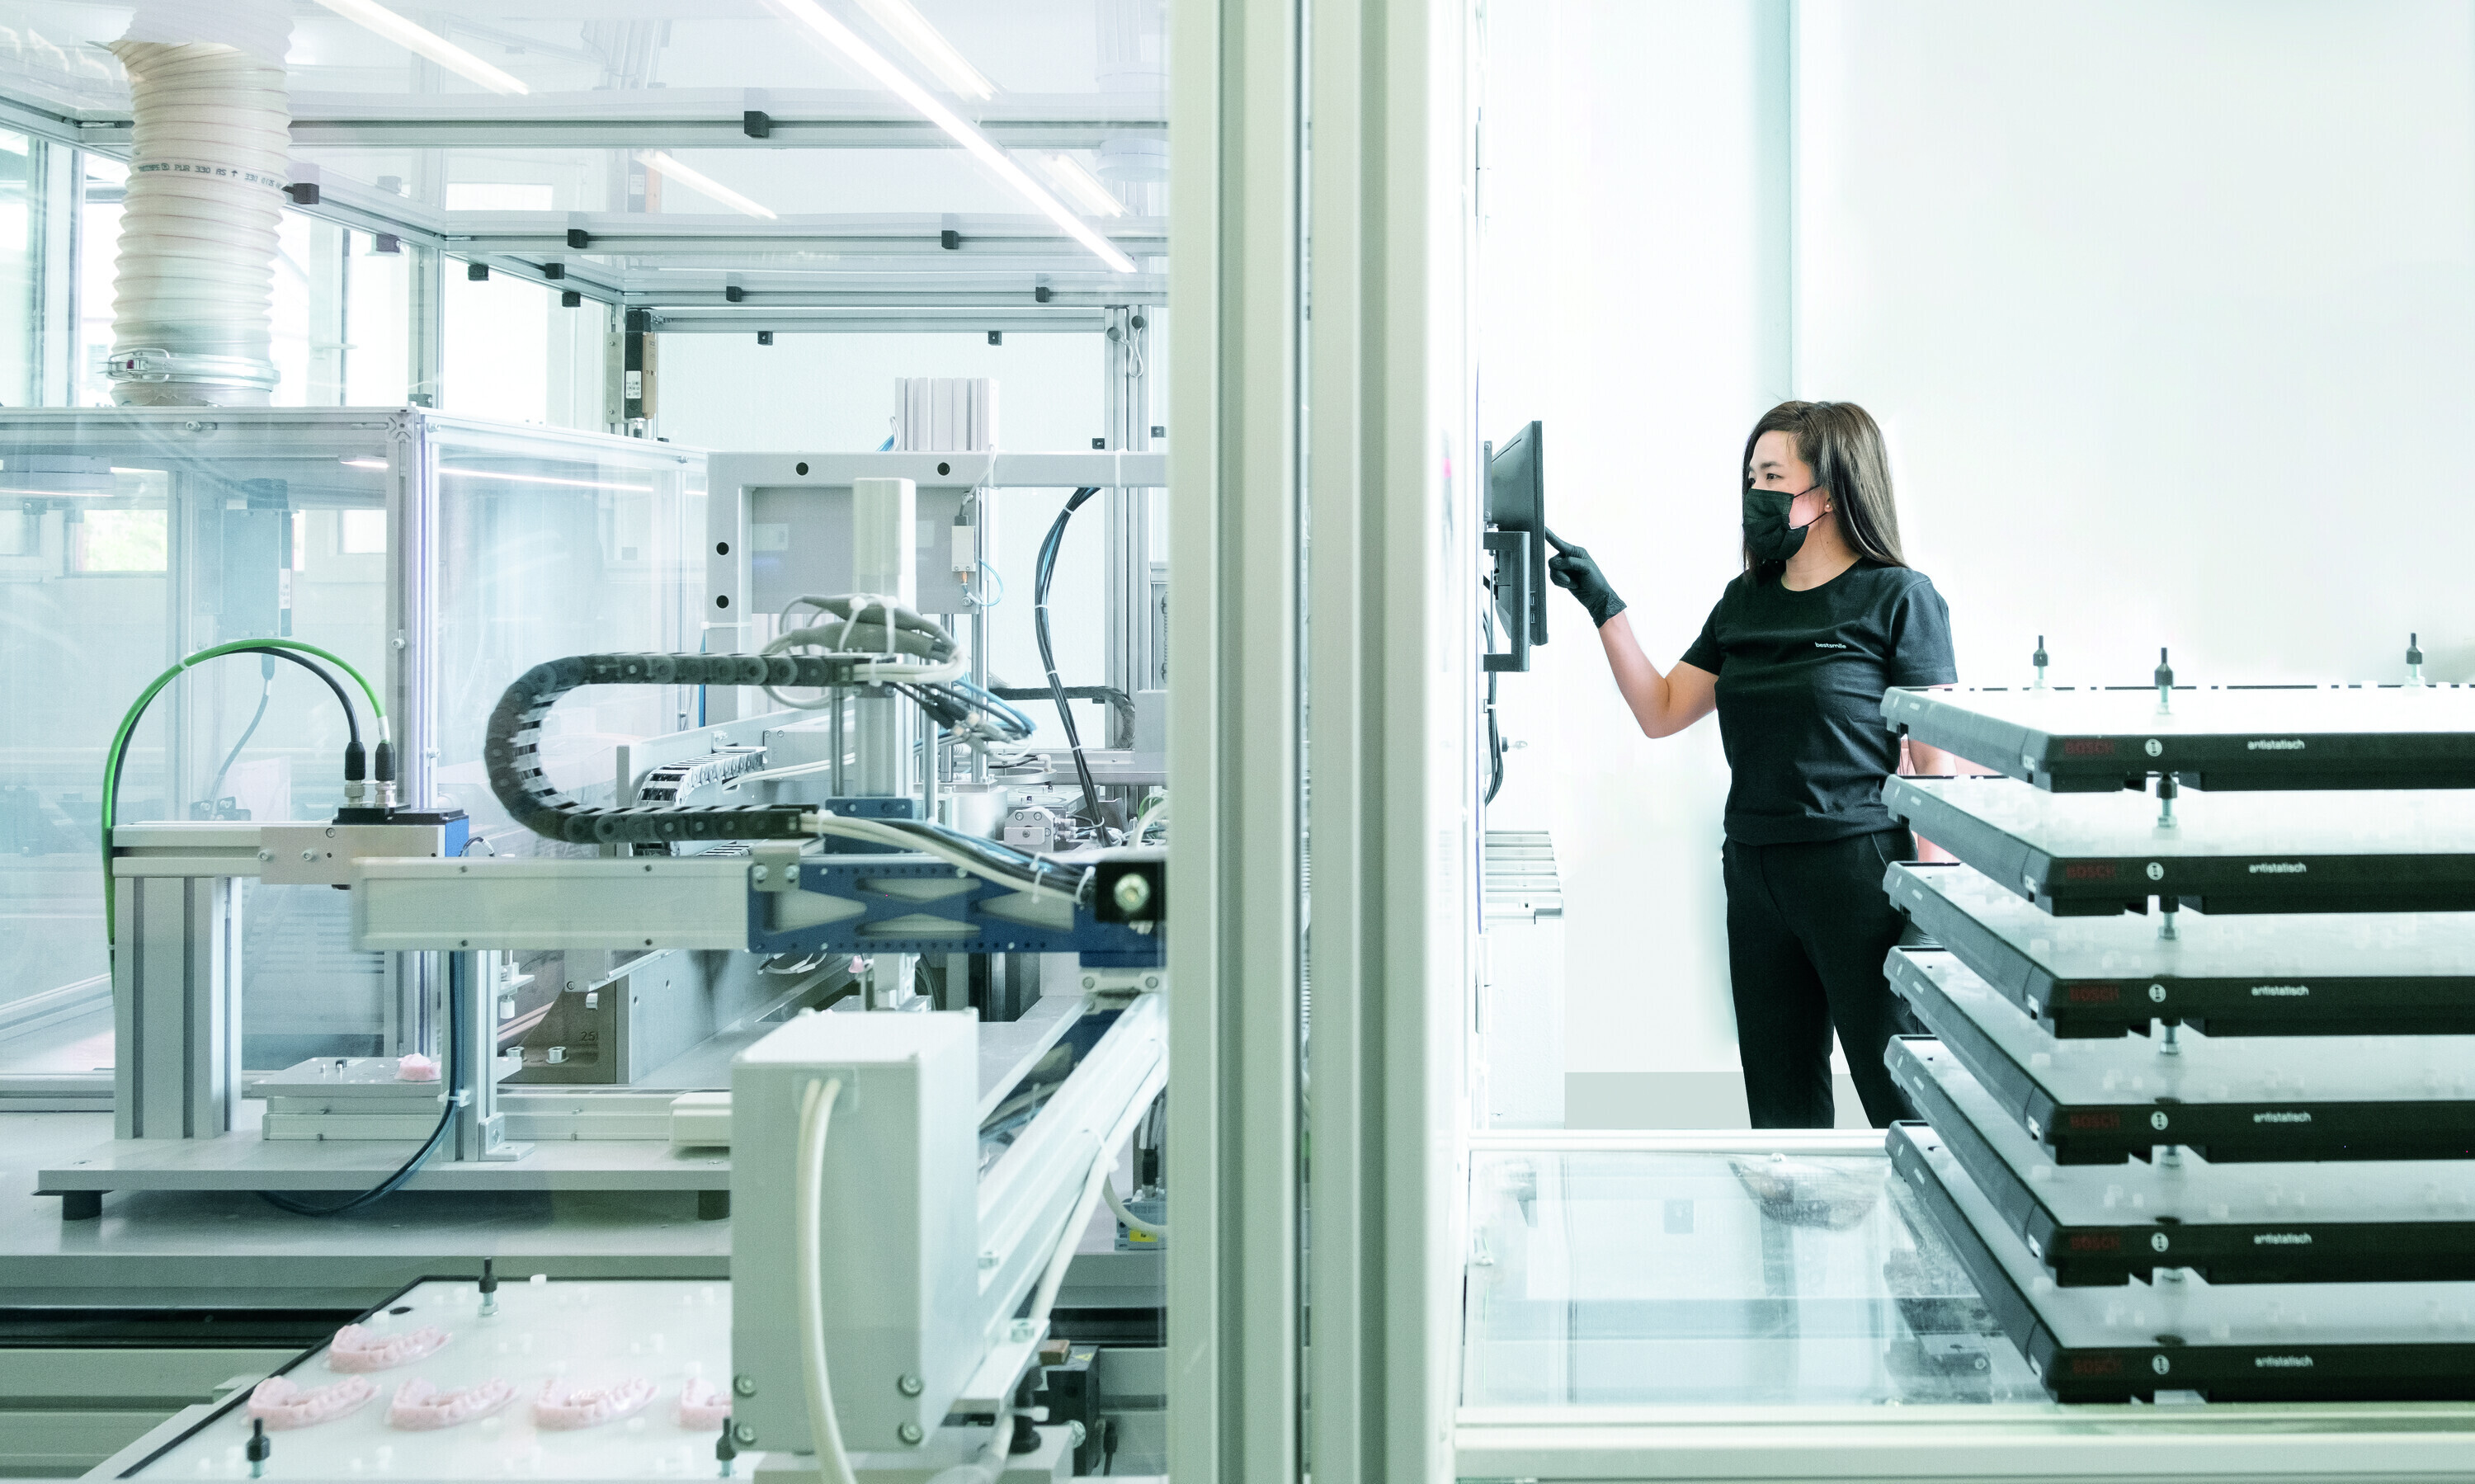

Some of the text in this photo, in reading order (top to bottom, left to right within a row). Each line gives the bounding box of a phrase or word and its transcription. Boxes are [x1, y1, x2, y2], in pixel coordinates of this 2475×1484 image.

[195, 165, 210, 173] 330
[2247, 739, 2305, 750] antistatisch
[2249, 862, 2307, 873] antistatisch
[2251, 985, 2309, 996] antistatisch
[2253, 1111, 2312, 1123] antistatisch
[2254, 1232, 2312, 1244] antistatisch
[2255, 1355, 2313, 1367] antistatisch
